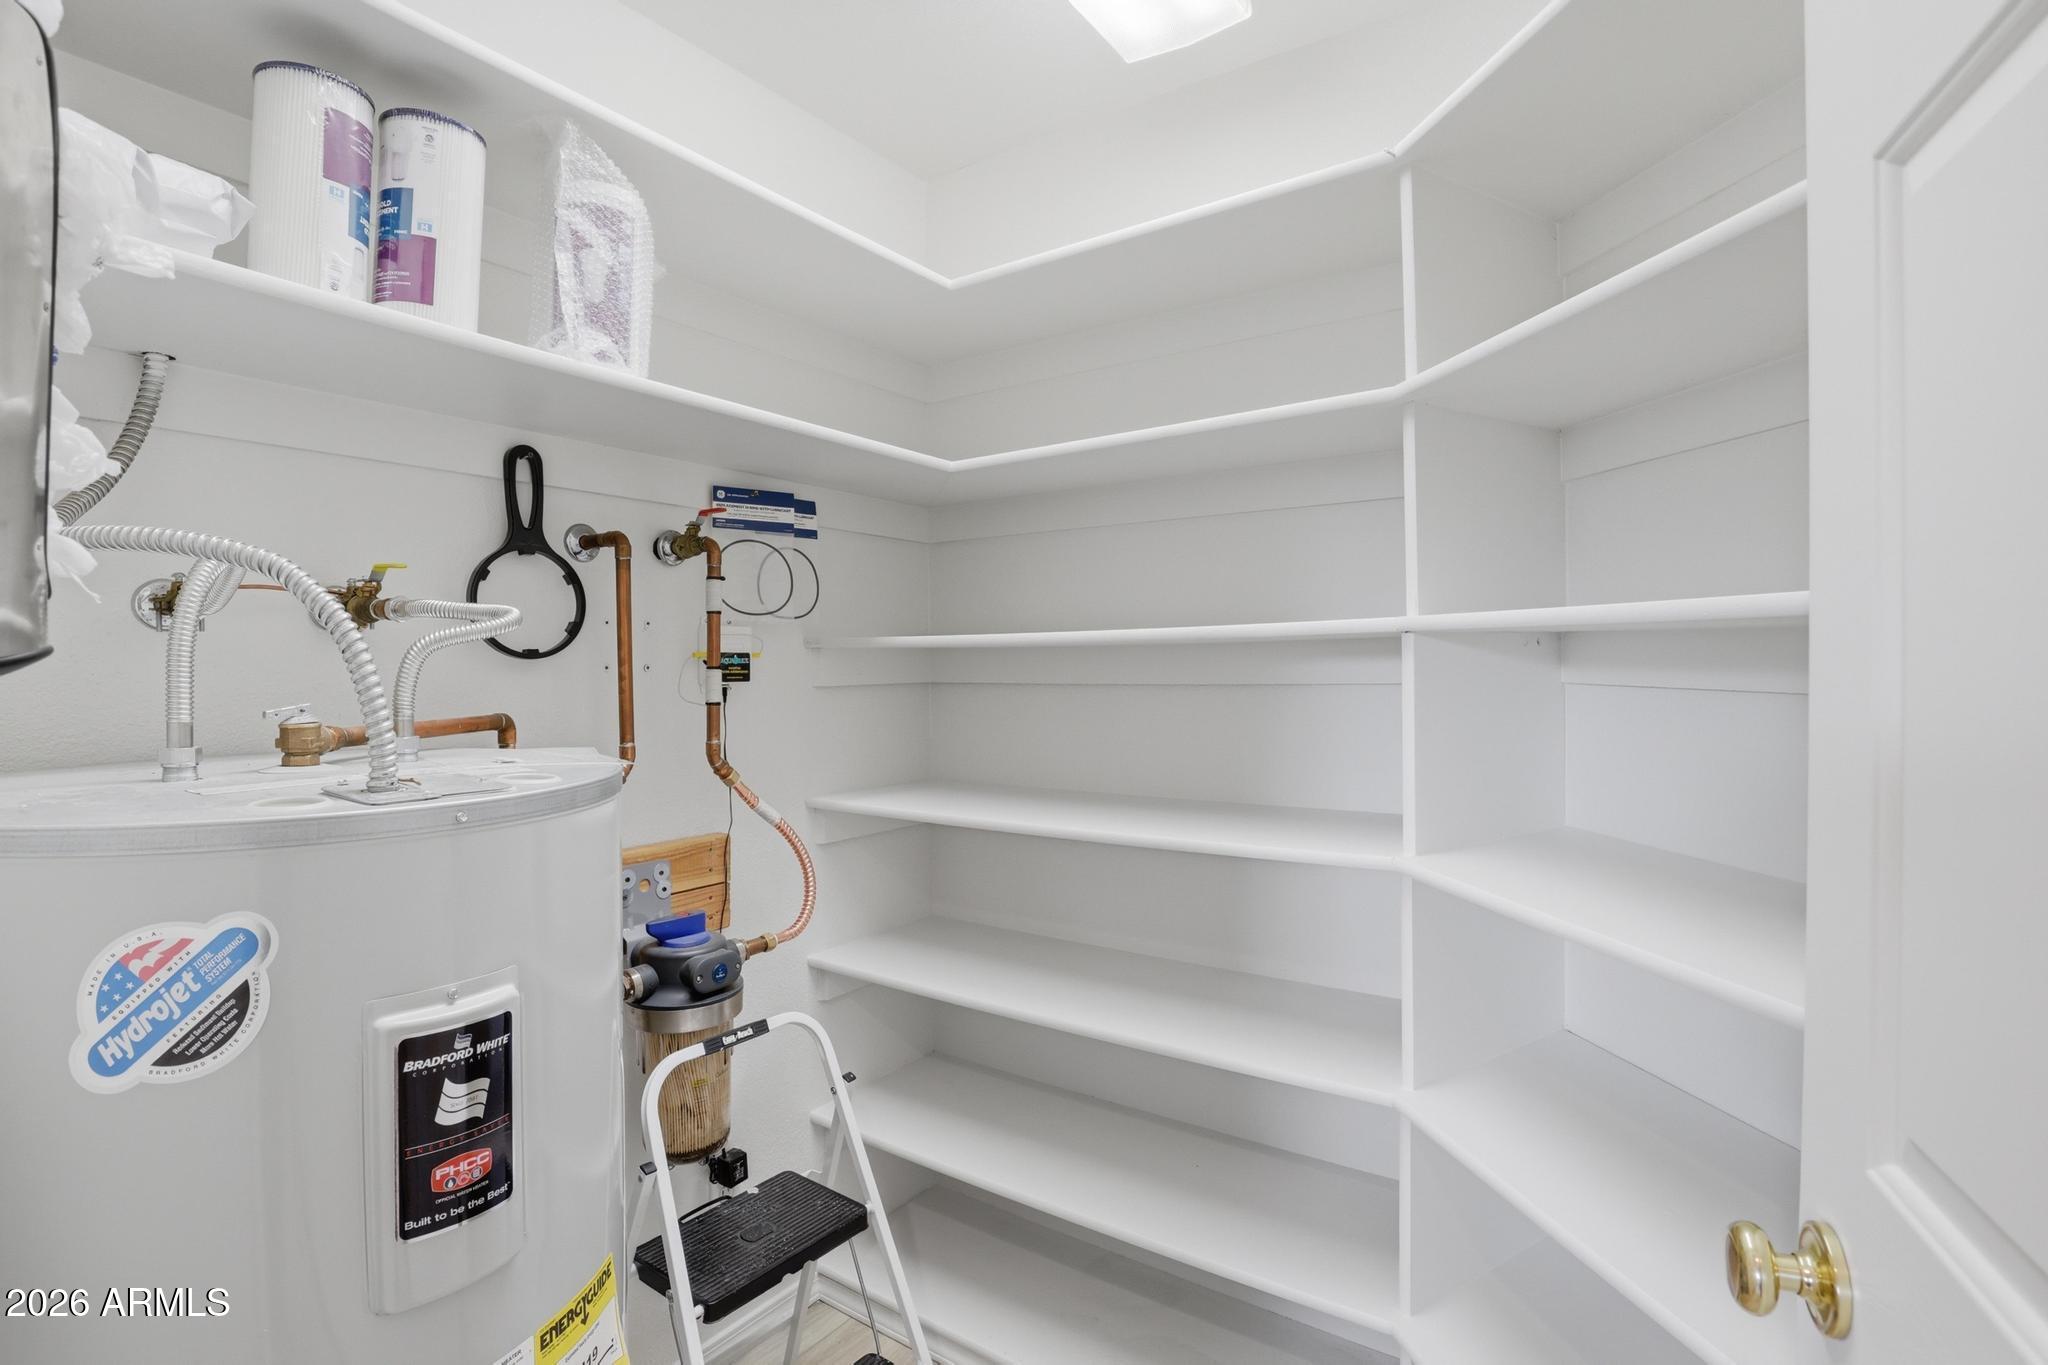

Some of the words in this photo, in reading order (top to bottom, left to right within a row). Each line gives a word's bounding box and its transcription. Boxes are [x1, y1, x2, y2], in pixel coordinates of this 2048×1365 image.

[193, 951, 214, 969] TOTAL
[199, 932, 247, 976] PERFORMANCE
[205, 957, 232, 983] SYSTEM
[88, 969, 102, 997] MADE
[105, 952, 116, 963] IN
[112, 977, 161, 1021] EQUIPPED
[166, 950, 192, 973] WITH
[98, 968, 202, 1067] Hydrojet
[166, 994, 221, 1043] FEATURING
[200, 1020, 226, 1042] Operating
[148, 1060, 206, 1076] BRADFORD
[212, 1038, 239, 1061] WHITE
[403, 1047, 474, 1073] BRADFORD
[476, 1033, 510, 1055] WHITE
[412, 1047, 503, 1078] CORPORATION
[406, 1136, 465, 1157] ENERGY
[435, 1151, 490, 1180] PHCC
[404, 1216, 432, 1231] Built
[434, 1212, 447, 1223] to
[450, 1205, 465, 1216] be
[467, 1197, 485, 1210] the
[487, 1183, 508, 1200] Best
[435, 1194, 456, 1205] OFFICIAL
